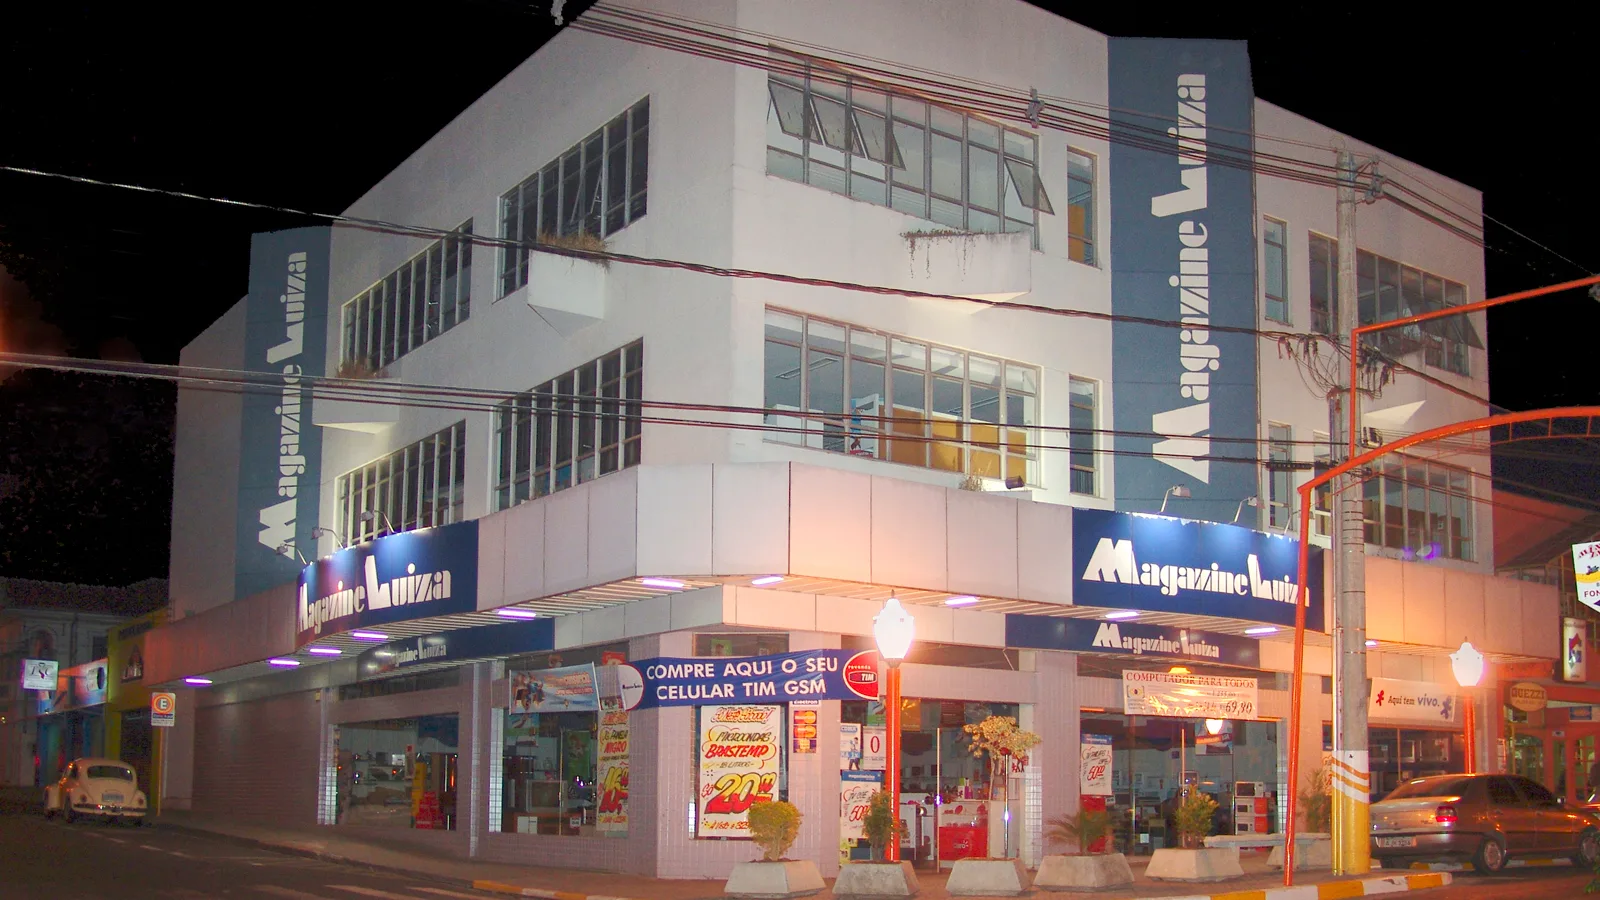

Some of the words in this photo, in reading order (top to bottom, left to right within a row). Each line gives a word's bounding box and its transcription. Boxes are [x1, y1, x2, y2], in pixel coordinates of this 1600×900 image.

[1151, 73, 1207, 218] Luiza
[266, 252, 307, 364] Luiza
[1152, 220, 1220, 484] Magazine
[258, 364, 306, 560] Magazine
[1082, 537, 1249, 597] Magazine
[364, 554, 452, 611] Luiza
[417, 637, 447, 659] Luiza
[1092, 622, 1181, 655] Magazine
[1179, 629, 1220, 659] Luiza
[646, 662, 715, 681] COMPRE
[723, 660, 773, 677] AQUI
[781, 658, 797, 674] O
[805, 657, 838, 673] SEU
[861, 673, 874, 681] TIM
[1126, 672, 1196, 685] COMPUTADOR
[1198, 676, 1223, 687] PARA
[1225, 679, 1255, 689] TODOS
[656, 681, 735, 701] CELULAR
[742, 681, 776, 697] TIM
[784, 678, 827, 695] GSM
[1388, 695, 1402, 706] Aqui
[1403, 697, 1415, 705] tem
[160, 698, 168, 709] E
[715, 732, 772, 743] MICROONDAS
[705, 743, 770, 760] BRASTEMP
